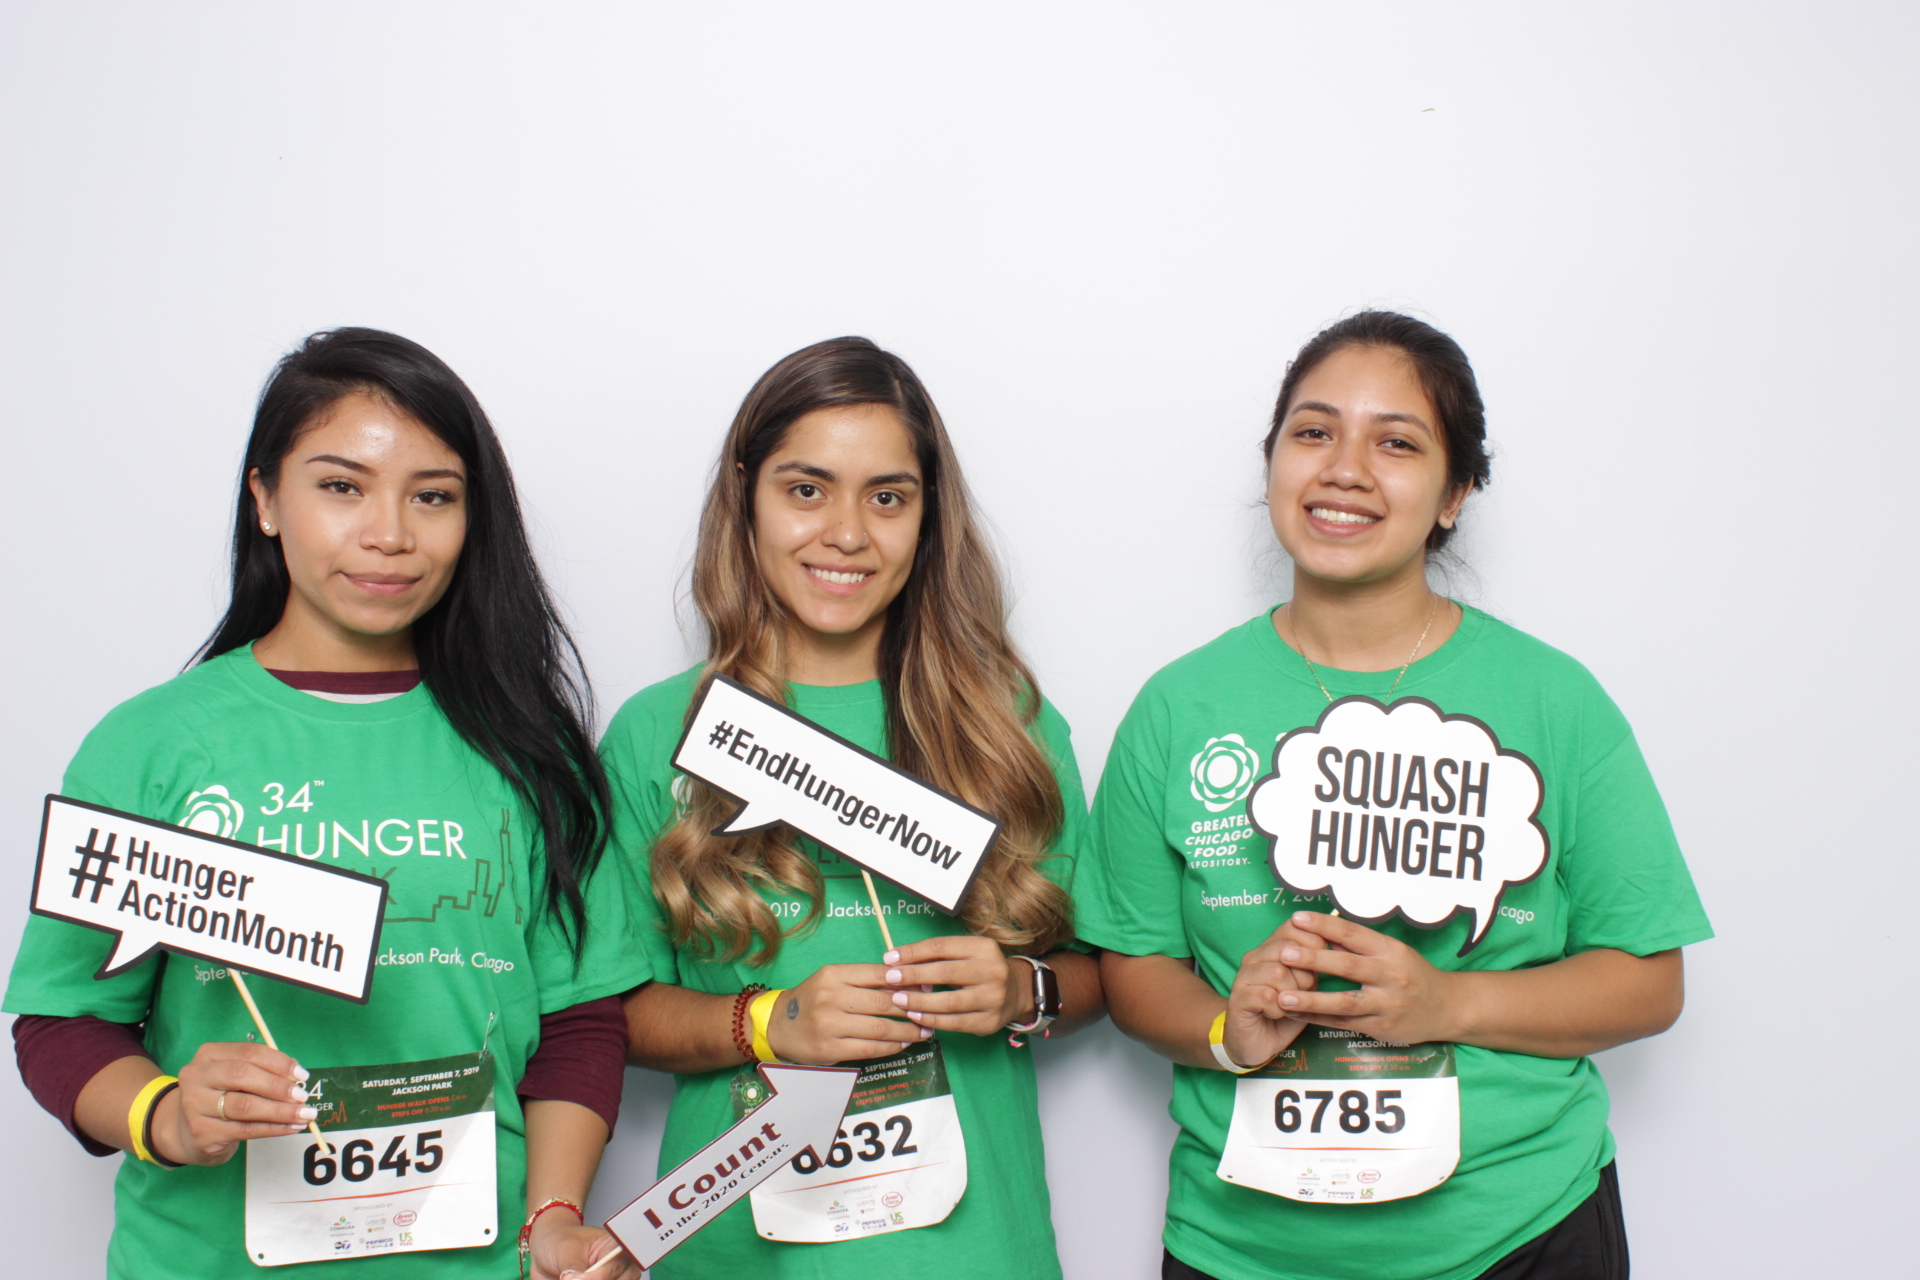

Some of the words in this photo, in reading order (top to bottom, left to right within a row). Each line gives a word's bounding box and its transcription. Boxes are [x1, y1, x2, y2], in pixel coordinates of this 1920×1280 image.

[1315, 746, 1490, 818] SQUASH
[708, 720, 962, 871] #EndHungerNow
[256, 818, 468, 860] HUNGER
[1185, 828, 1254, 846] CHICAGO
[1307, 809, 1486, 881] HUNGER
[770, 902, 801, 917] 019
[897, 899, 935, 917] Park,
[1201, 889, 1269, 911] September
[118, 879, 344, 972] ActionMonth
[374, 948, 424, 966] ckson
[429, 948, 465, 967] Park,
[865, 1059, 907, 1073] SEPTEMBER
[916, 1052, 934, 1061] 2019
[362, 1077, 408, 1089] SATURDAY,
[410, 1071, 454, 1083] SEPTEMBER
[463, 1066, 480, 1076] 2019
[857, 1072, 886, 1084] CKSON
[887, 1068, 909, 1077] PARK
[391, 1083, 430, 1096] JACKSON
[432, 1081, 453, 1090] PARK
[868, 1086, 887, 1095] WALK
[888, 1082, 910, 1091] OPENS
[377, 1102, 406, 1111] HUNGER
[408, 1099, 427, 1108] WALK
[428, 1096, 450, 1104] OPENS
[855, 1098, 873, 1106] STEPS
[1275, 1089, 1406, 1134] 6785
[391, 1110, 410, 1118] STEPS
[411, 1108, 423, 1116] OFF
[303, 1130, 444, 1186] 6645
[642, 1208, 663, 1230] I
[668, 1122, 782, 1210] Count
[658, 1229, 674, 1242] in
[676, 1209, 700, 1228] the
[702, 1179, 738, 1210] 2020
[740, 1142, 789, 1179] Census
